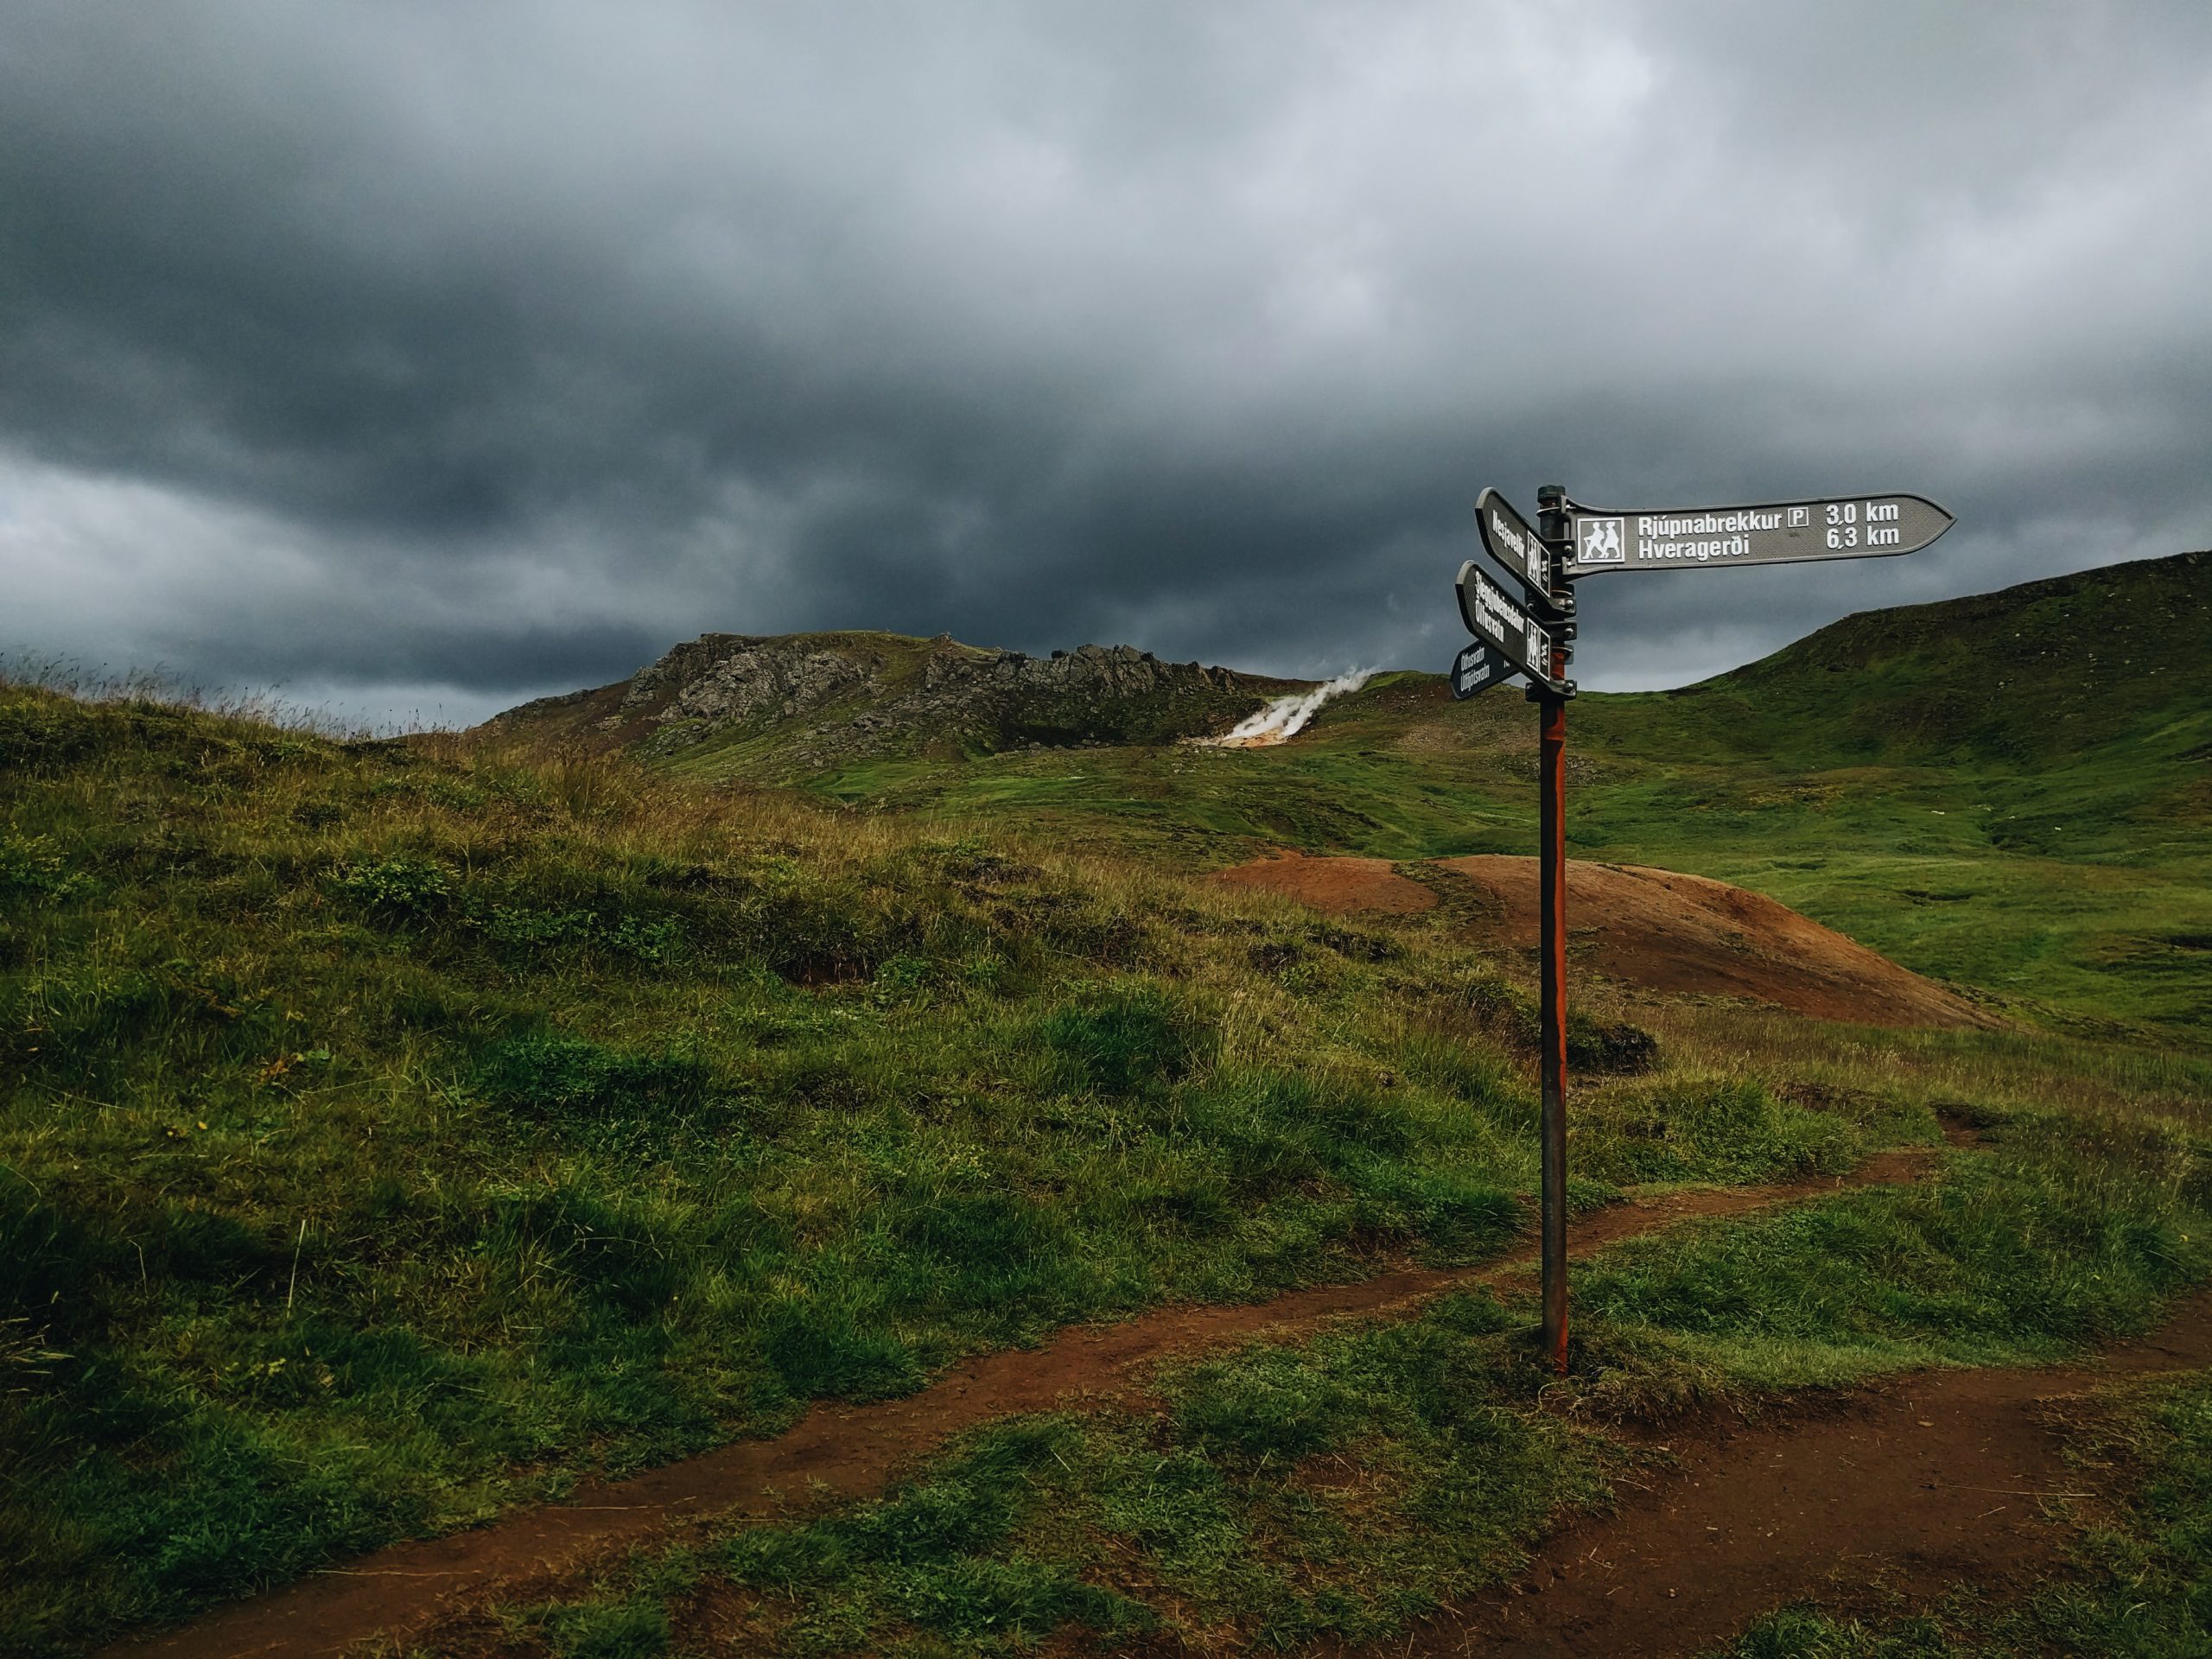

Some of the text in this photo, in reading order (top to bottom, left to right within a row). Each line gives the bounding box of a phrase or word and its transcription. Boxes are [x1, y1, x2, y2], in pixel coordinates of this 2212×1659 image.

[1638, 502, 1899, 537] Rjúpnabrekkur P 3,0 km
[1638, 526, 1899, 562] Hveragerði 6,3 km
